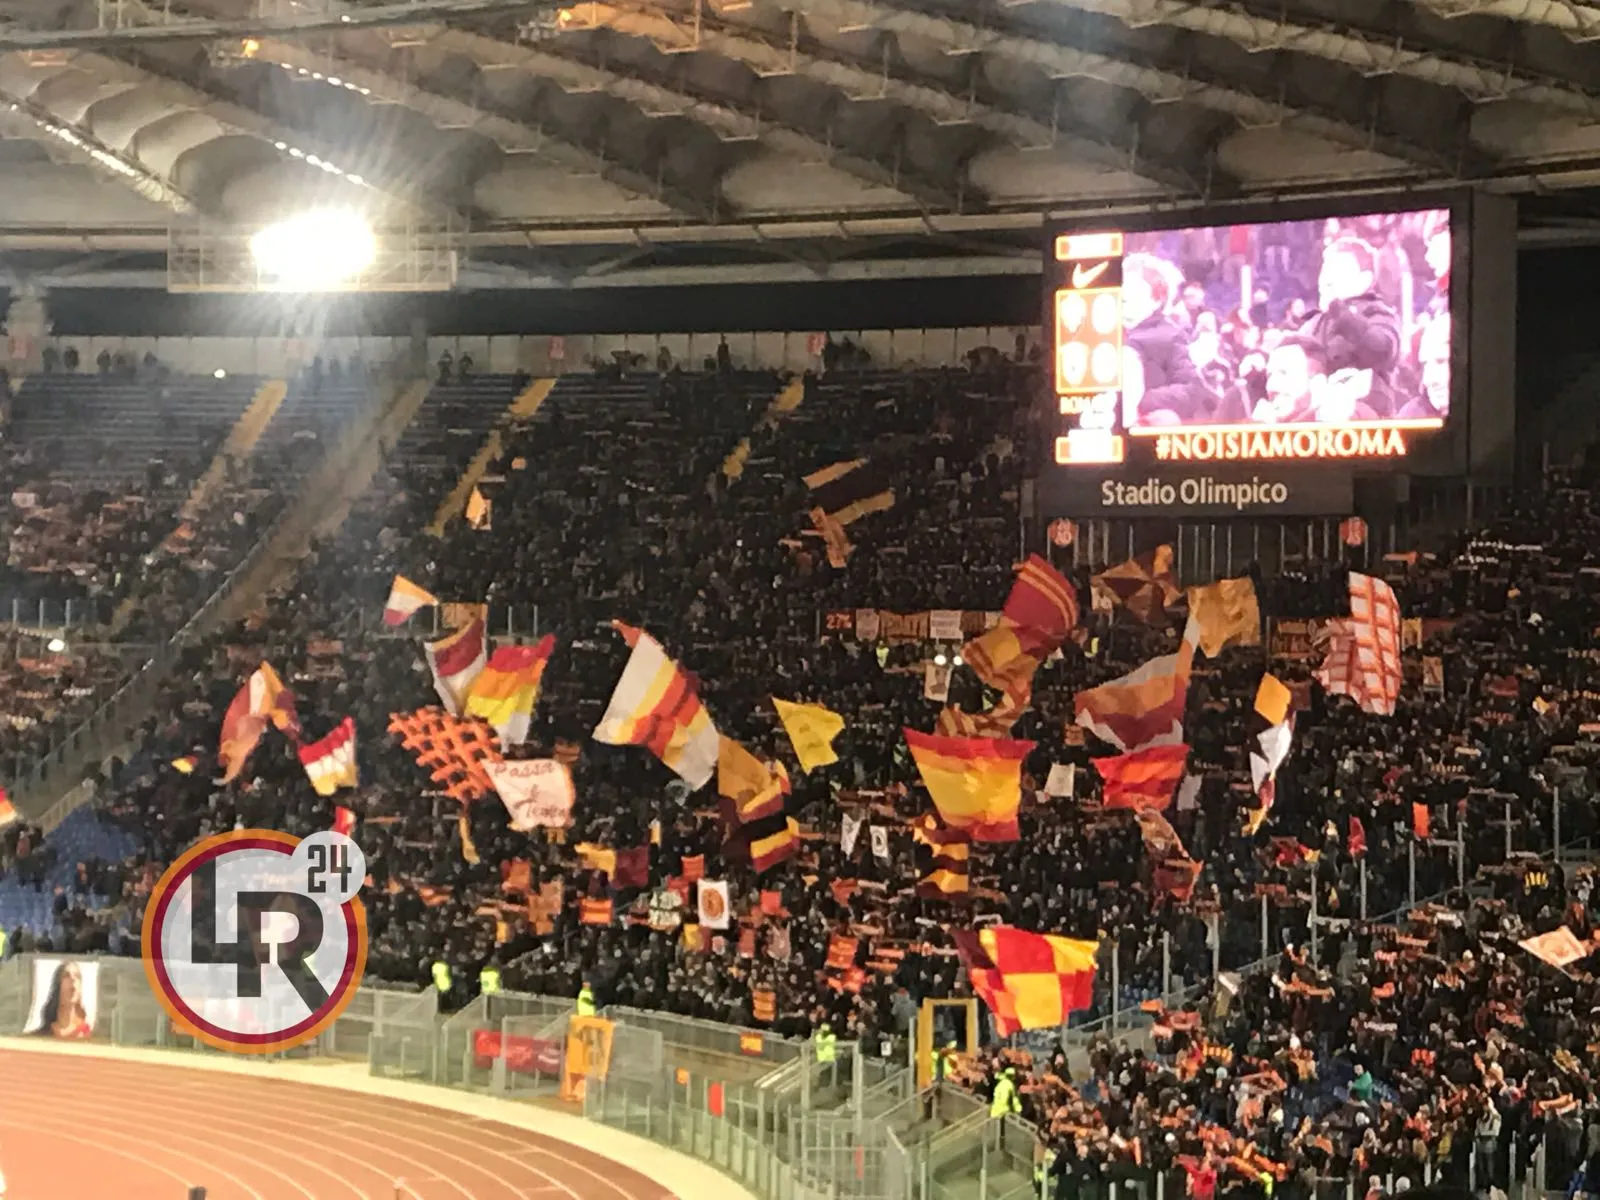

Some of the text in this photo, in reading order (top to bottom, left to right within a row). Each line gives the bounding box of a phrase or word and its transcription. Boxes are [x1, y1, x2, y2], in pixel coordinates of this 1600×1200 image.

[1156, 429, 1406, 460] #NOISIAMOROMA
[1102, 476, 1288, 510] Stadio Olimpico
